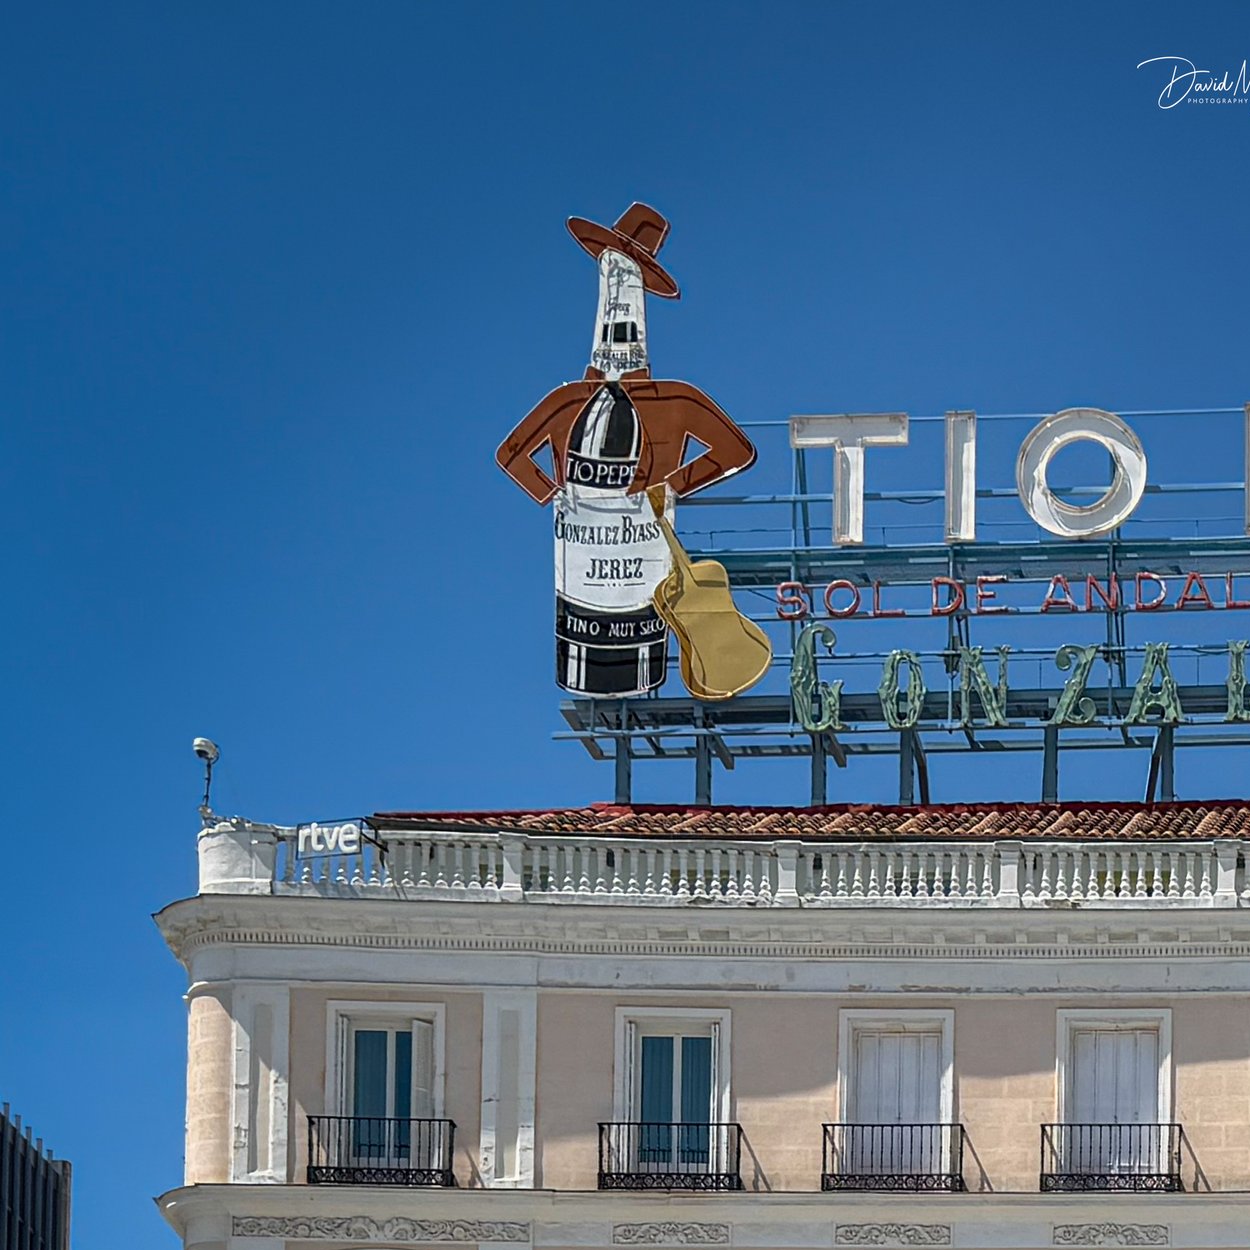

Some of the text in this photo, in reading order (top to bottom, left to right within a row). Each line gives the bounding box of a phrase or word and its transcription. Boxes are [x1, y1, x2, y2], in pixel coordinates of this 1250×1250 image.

[567, 457, 594, 482] TIO
[790, 406, 1147, 547] TIO
[555, 509, 661, 546] GONZALEZ BYASS
[586, 557, 643, 580] JEREZ
[776, 579, 906, 620] SOL
[931, 574, 1009, 615] DE
[567, 615, 600, 636] FINO
[608, 622, 636, 638] MUY
[298, 821, 360, 853] rtve
